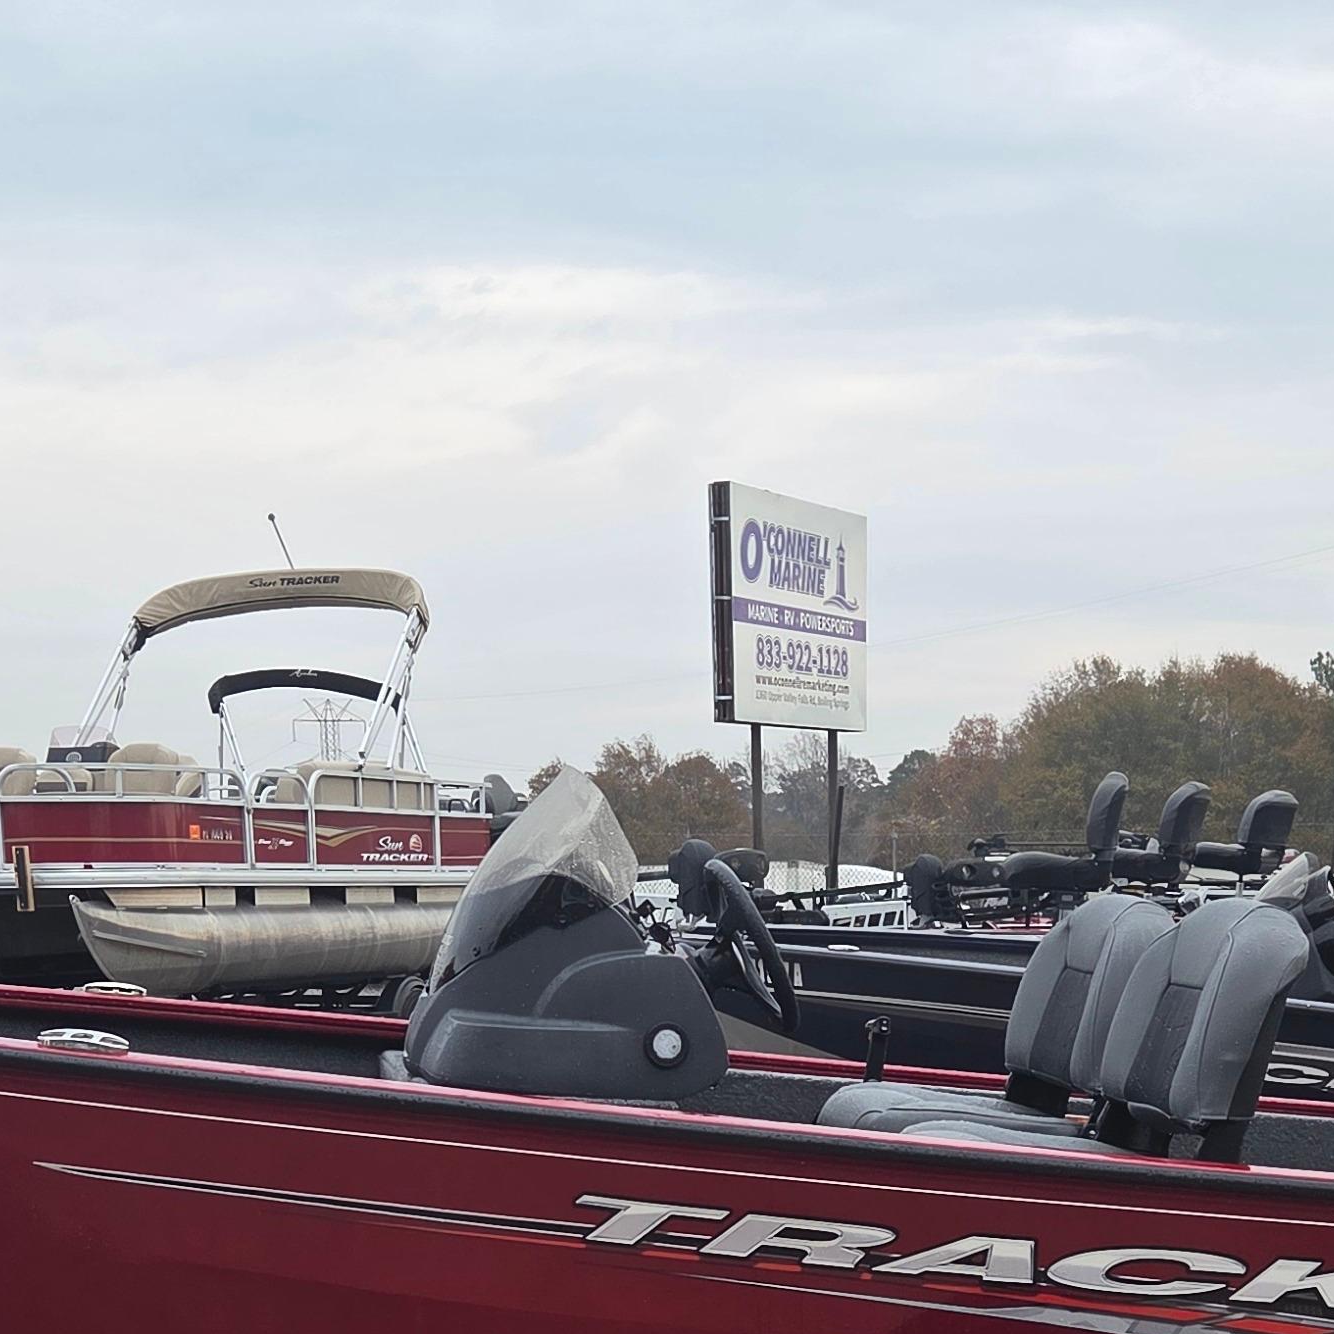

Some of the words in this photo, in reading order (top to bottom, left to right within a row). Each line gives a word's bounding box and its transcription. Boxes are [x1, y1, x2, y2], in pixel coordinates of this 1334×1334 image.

[740, 518, 831, 583] O'CONNELL
[249, 578, 277, 588] Sun
[279, 575, 340, 587] TRACKER
[768, 557, 825, 598] MARINE
[748, 603, 779, 624] MARINE
[784, 609, 795, 626] RV
[800, 612, 855, 637] POWERSPORTS
[755, 633, 850, 680] 833-922-1128
[360, 853, 429, 862] TRACKER
[376, 835, 404, 851] Sun
